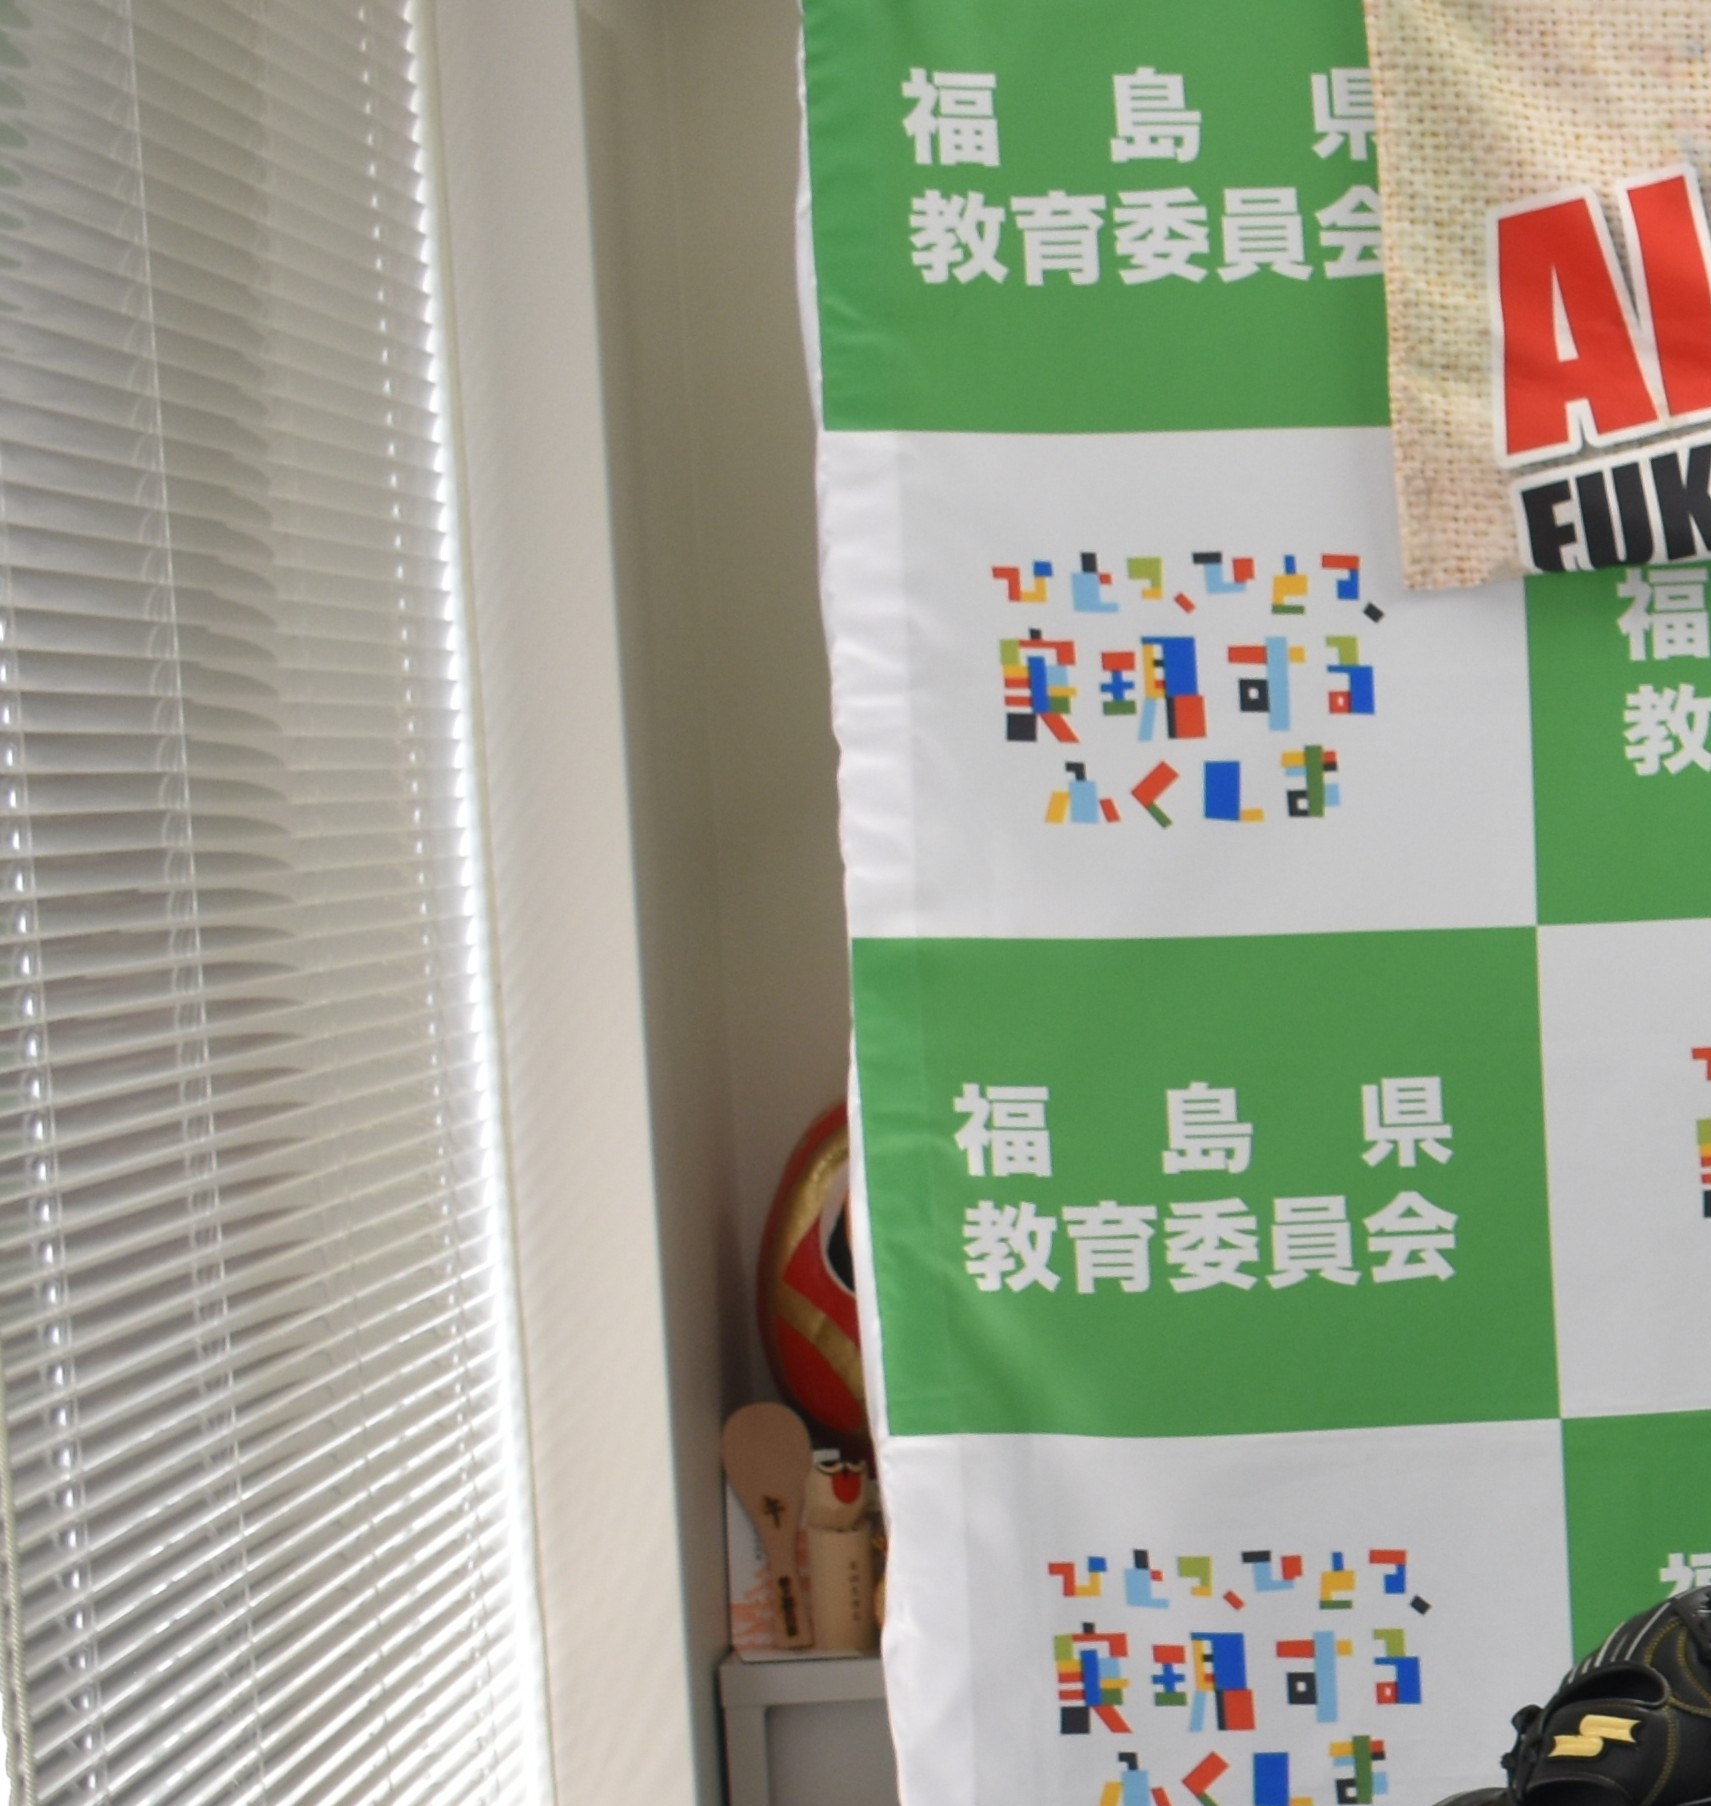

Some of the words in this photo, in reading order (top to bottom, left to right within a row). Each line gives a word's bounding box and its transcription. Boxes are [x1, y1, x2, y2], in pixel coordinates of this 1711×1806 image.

[902, 66, 1376, 167] 福島県
[909, 185, 1385, 286] 教育委員会
[954, 1076, 1453, 1177] 福島県
[963, 1190, 1458, 1294] 教育委員会
